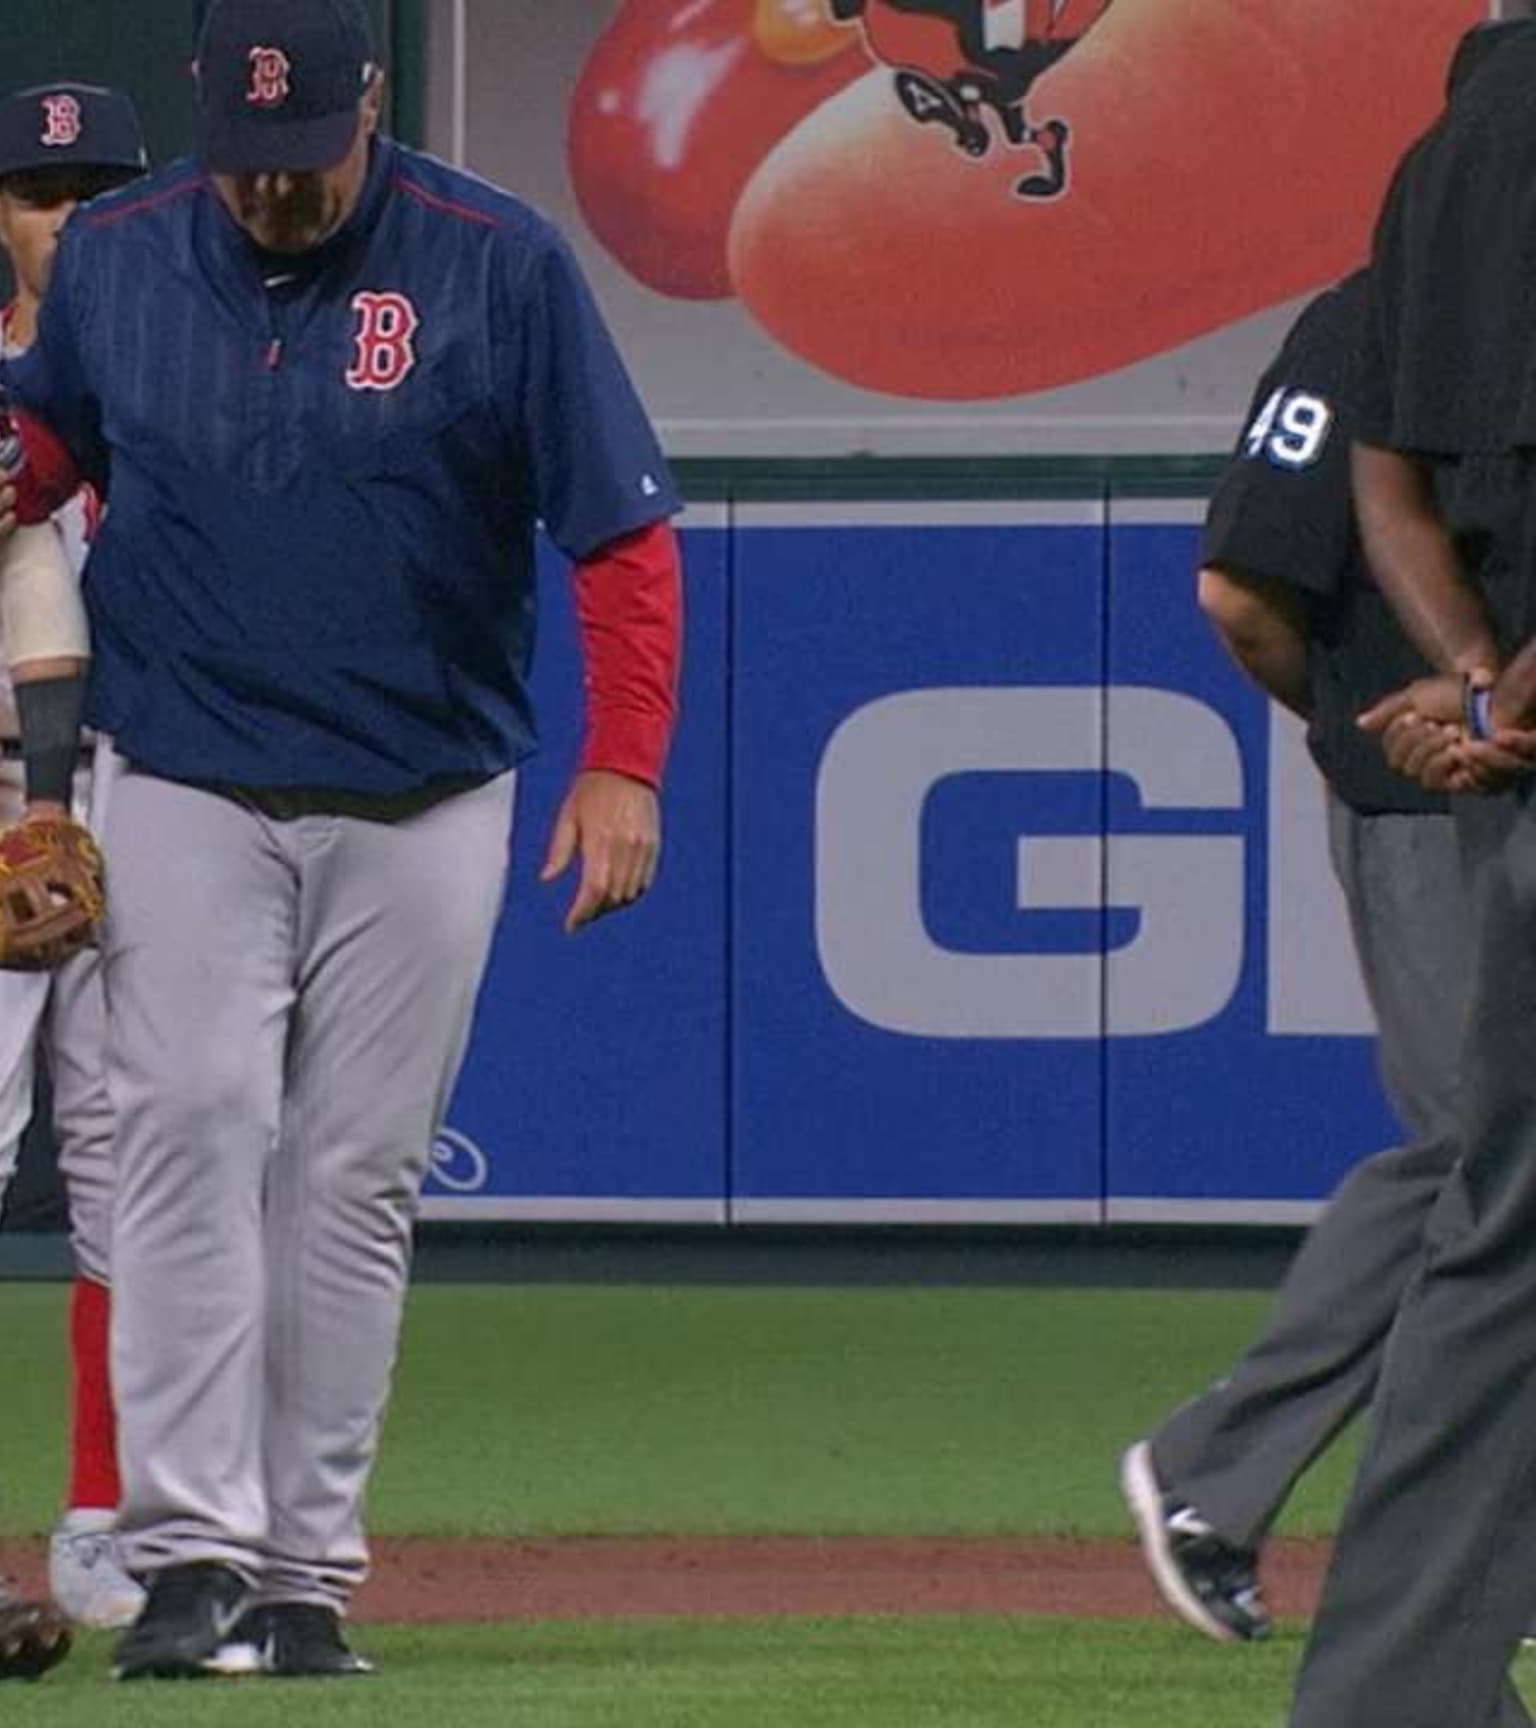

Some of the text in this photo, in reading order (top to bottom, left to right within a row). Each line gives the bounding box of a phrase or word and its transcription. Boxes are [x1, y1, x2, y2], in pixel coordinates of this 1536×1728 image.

[247, 46, 290, 107] B
[40, 93, 81, 146] B
[345, 290, 419, 391] B
